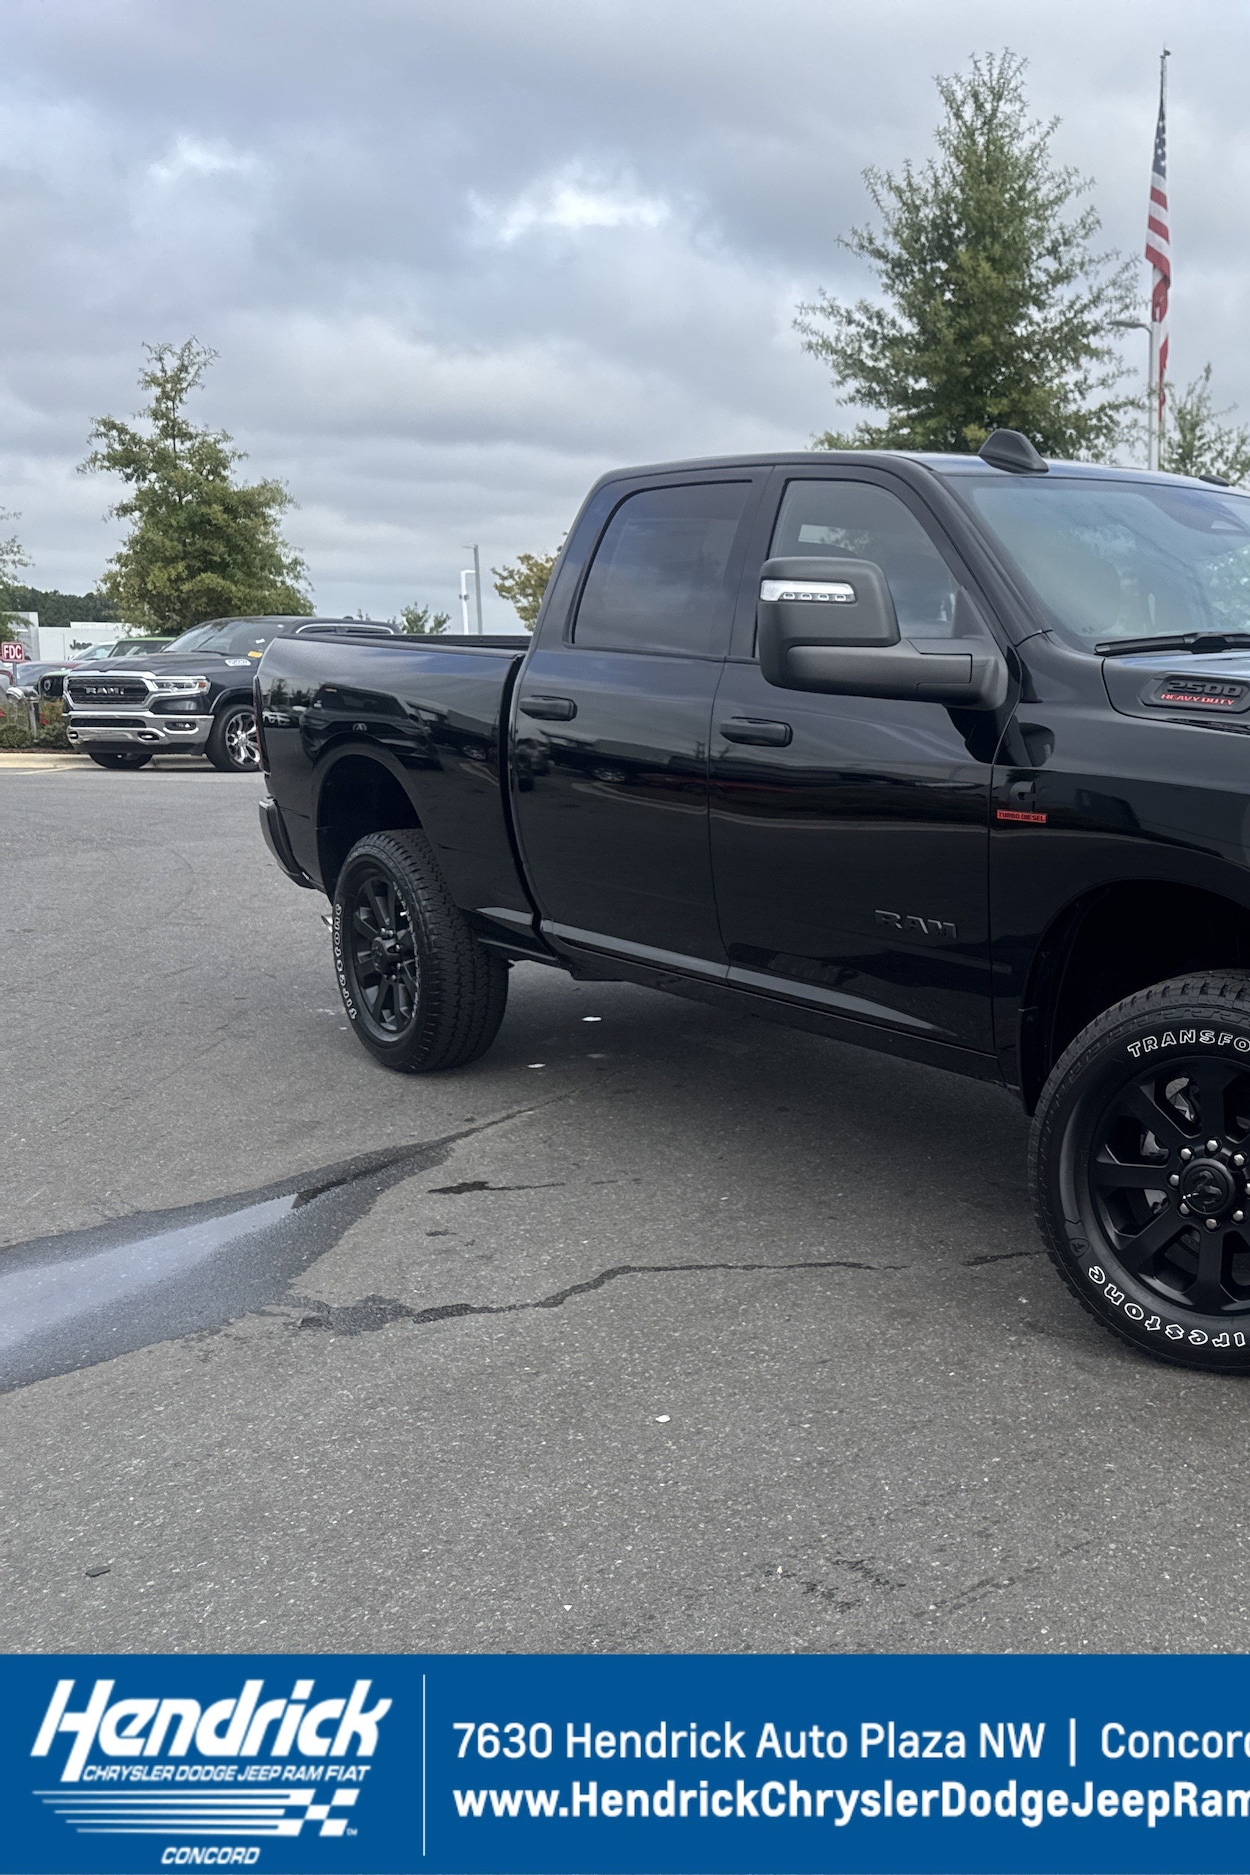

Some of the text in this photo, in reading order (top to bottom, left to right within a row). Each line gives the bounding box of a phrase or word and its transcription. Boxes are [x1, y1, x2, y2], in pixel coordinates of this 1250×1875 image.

[3, 644, 22, 659] FDC
[84, 687, 124, 695] RAM
[1167, 680, 1243, 698] 2500
[1160, 693, 1235, 706] HEAVY DUTY
[874, 909, 958, 939] RAM
